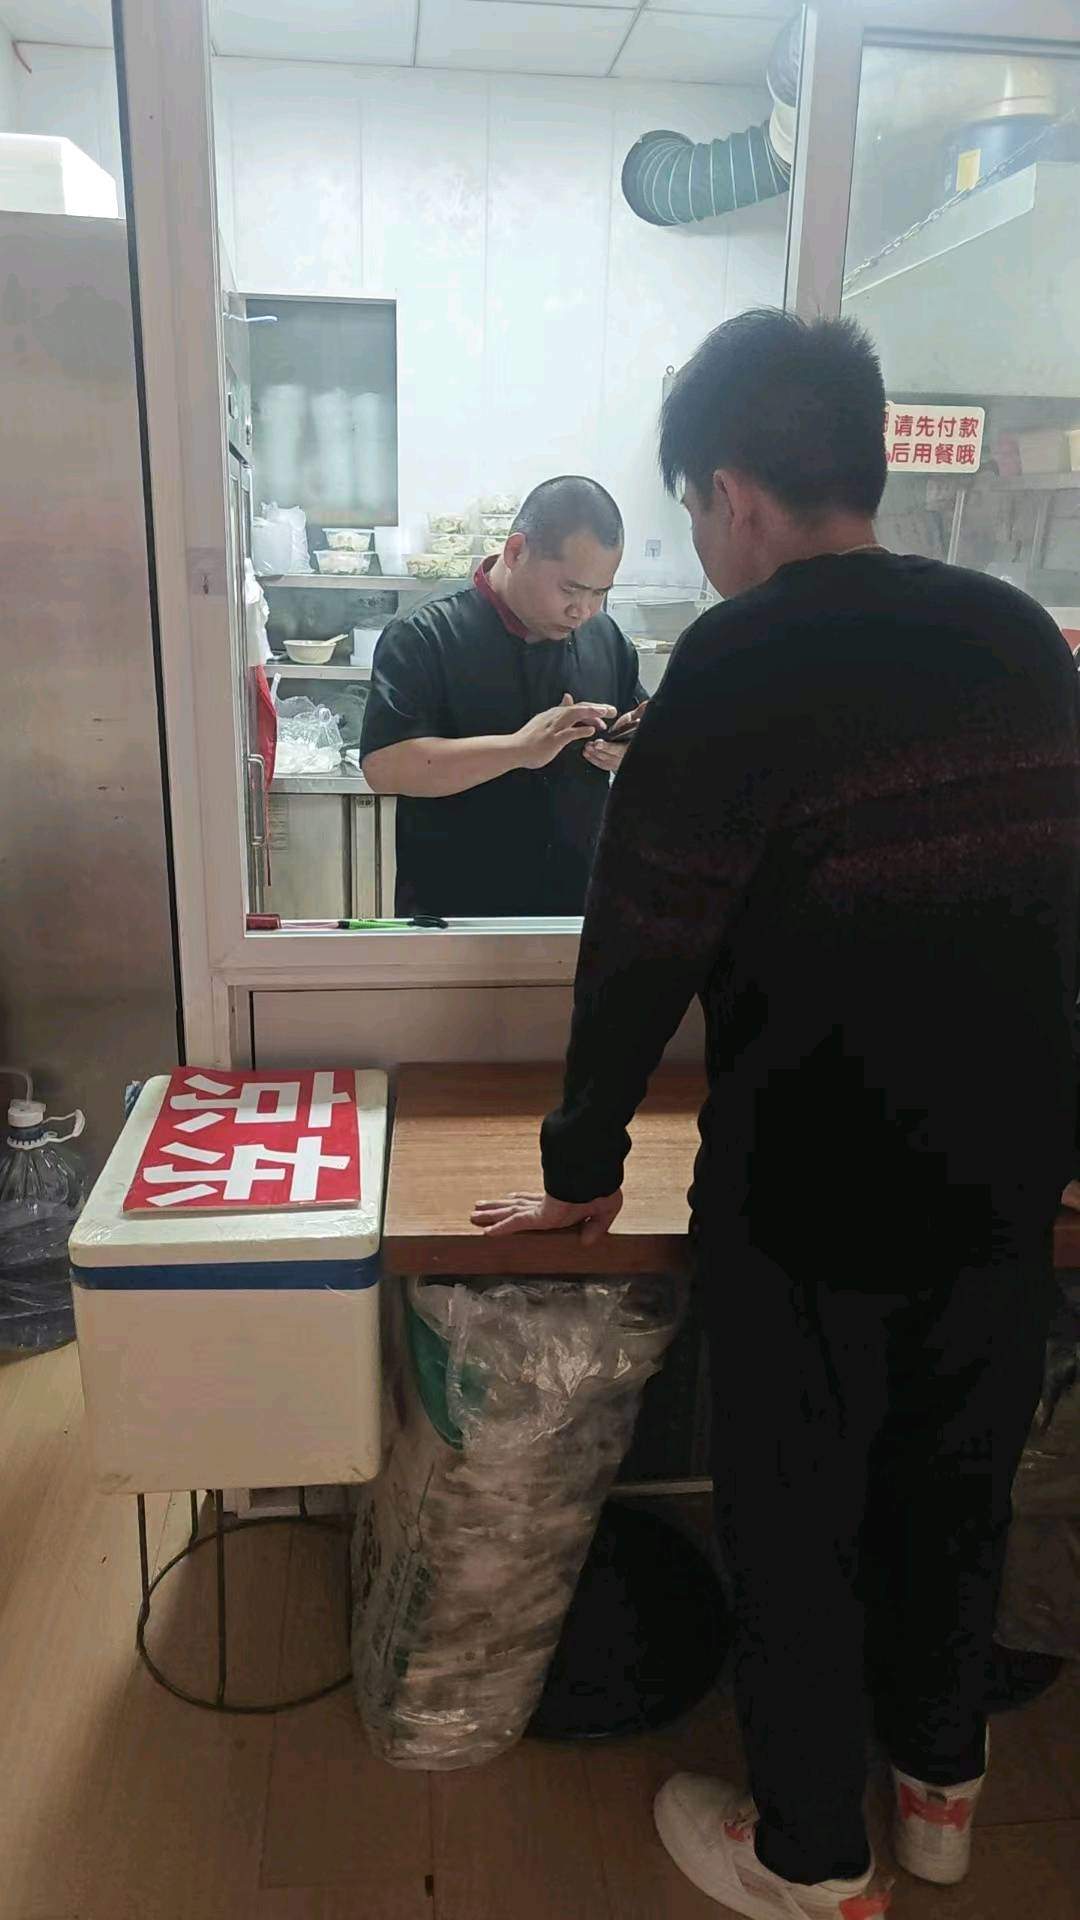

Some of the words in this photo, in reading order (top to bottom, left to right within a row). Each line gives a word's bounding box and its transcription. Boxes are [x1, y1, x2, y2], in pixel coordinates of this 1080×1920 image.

[883, 414, 979, 438] 请先付款
[886, 443, 976, 465] 后用餐哦
[143, 1071, 351, 1206] 京东
